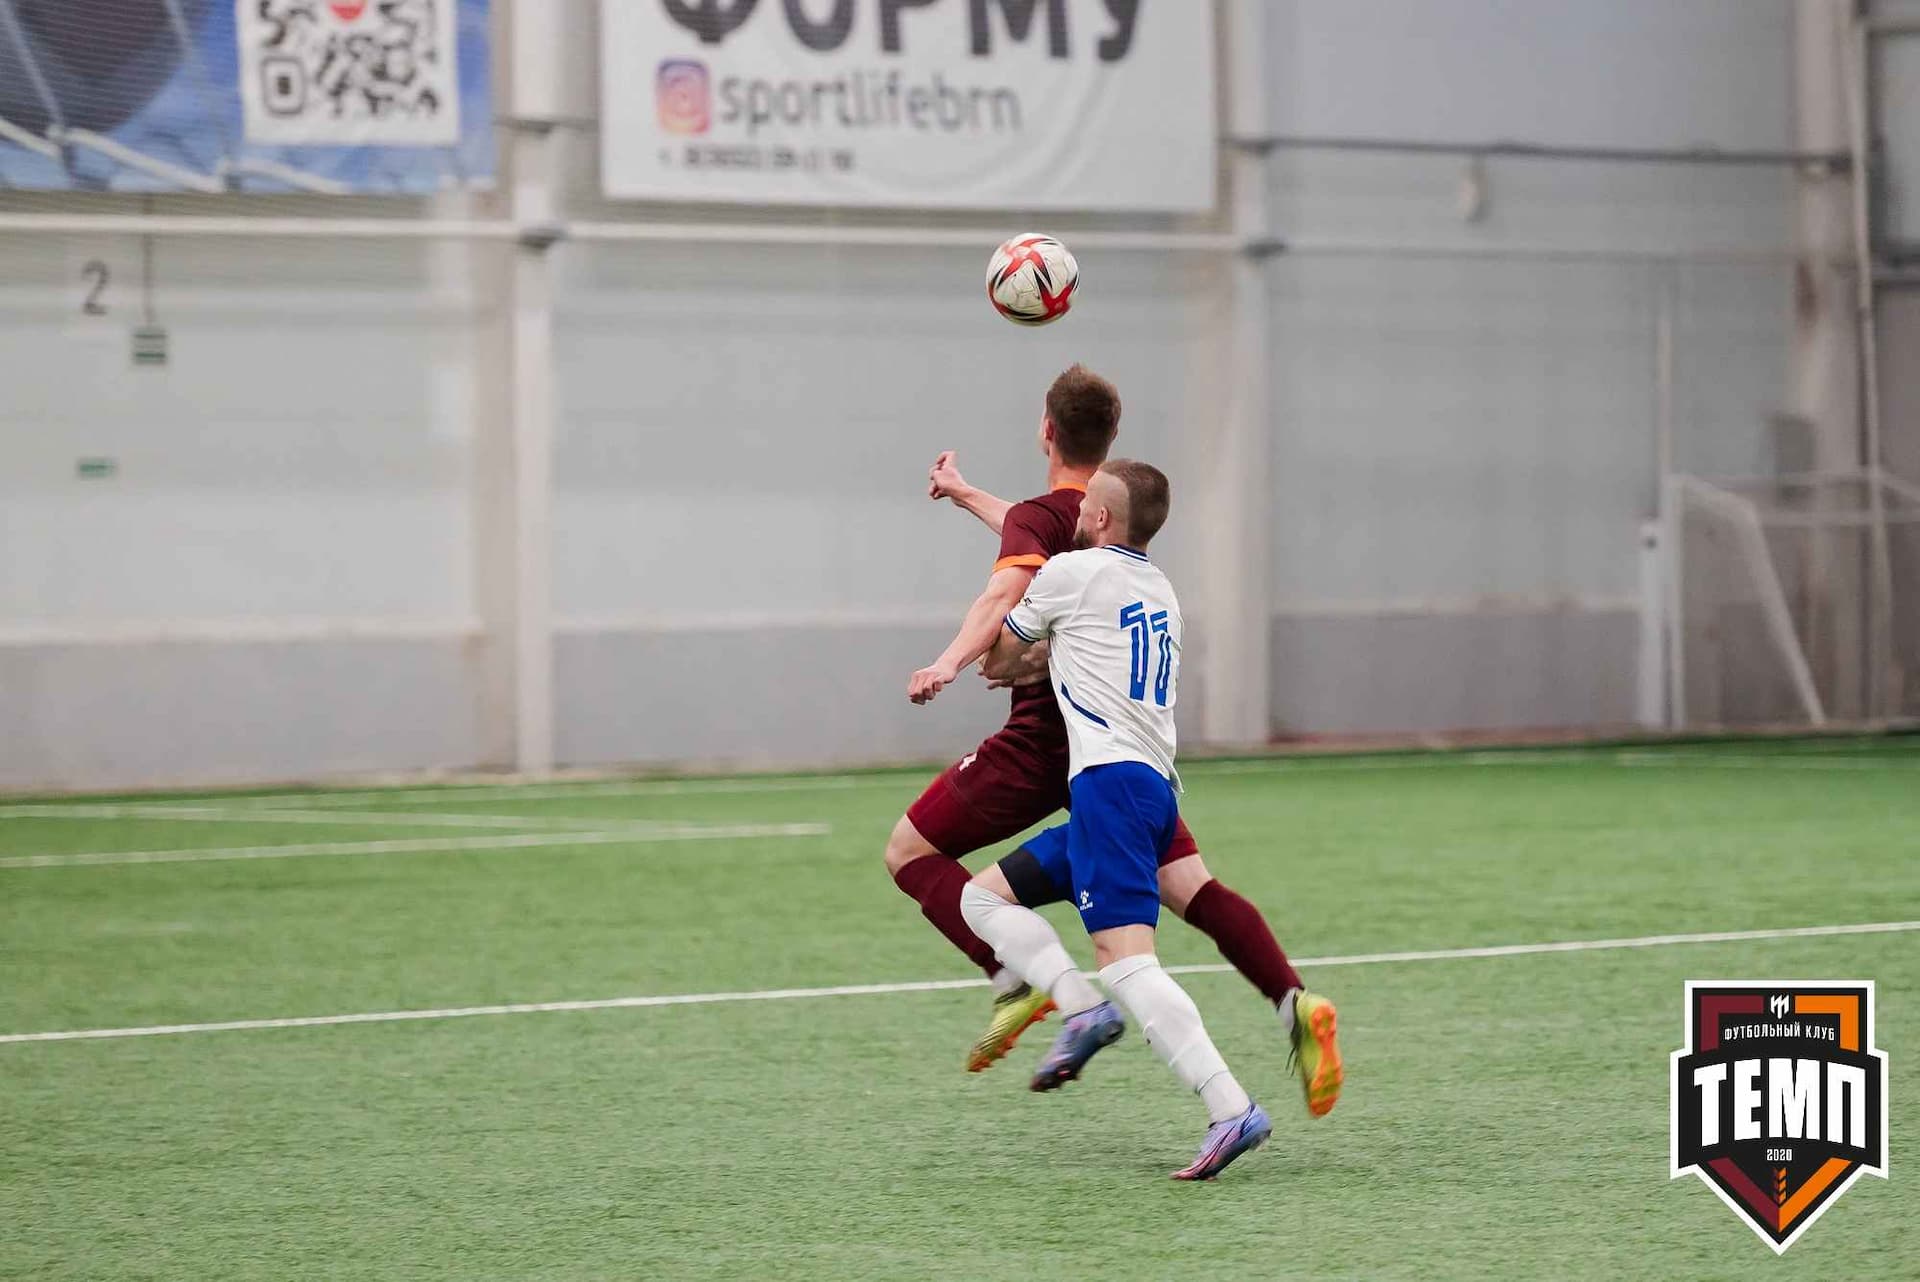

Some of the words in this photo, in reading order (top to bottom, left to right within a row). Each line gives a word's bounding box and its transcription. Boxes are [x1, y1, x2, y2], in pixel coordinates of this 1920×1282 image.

[719, 68, 1024, 137] sportlifebrn
[81, 259, 109, 315] 2
[1120, 600, 1172, 707] 11
